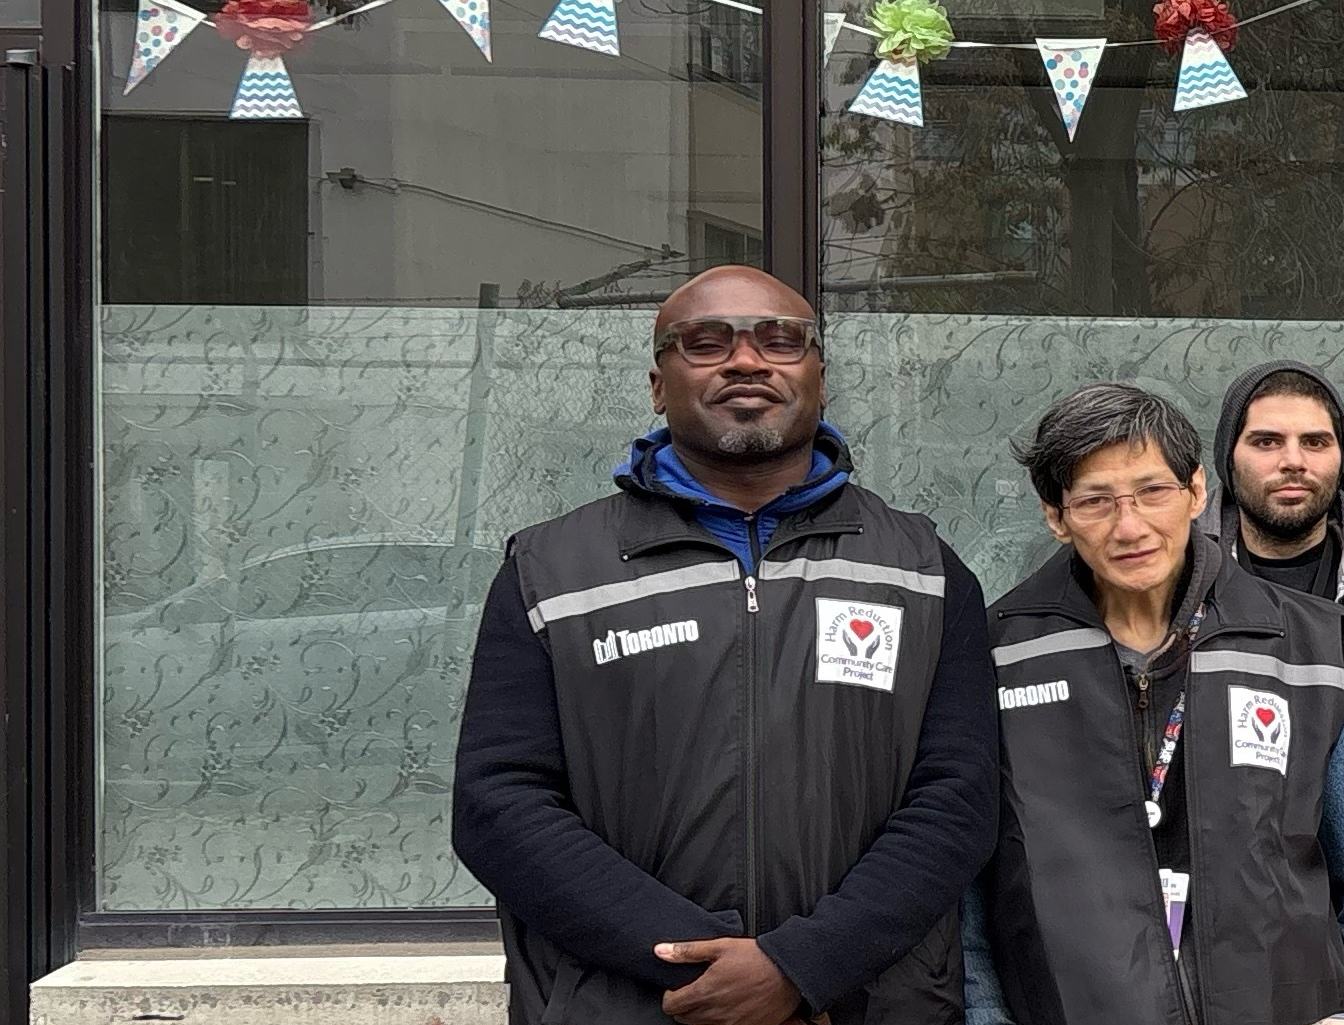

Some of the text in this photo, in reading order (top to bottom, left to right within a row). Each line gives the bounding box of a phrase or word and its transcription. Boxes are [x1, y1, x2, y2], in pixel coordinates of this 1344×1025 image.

[616, 620, 699, 656] TORONTO
[825, 606, 893, 651] Harm Reduction
[821, 654, 875, 670] Community
[843, 667, 874, 681] Project
[998, 680, 1070, 710] TORONTO
[1236, 700, 1254, 729] Harm
